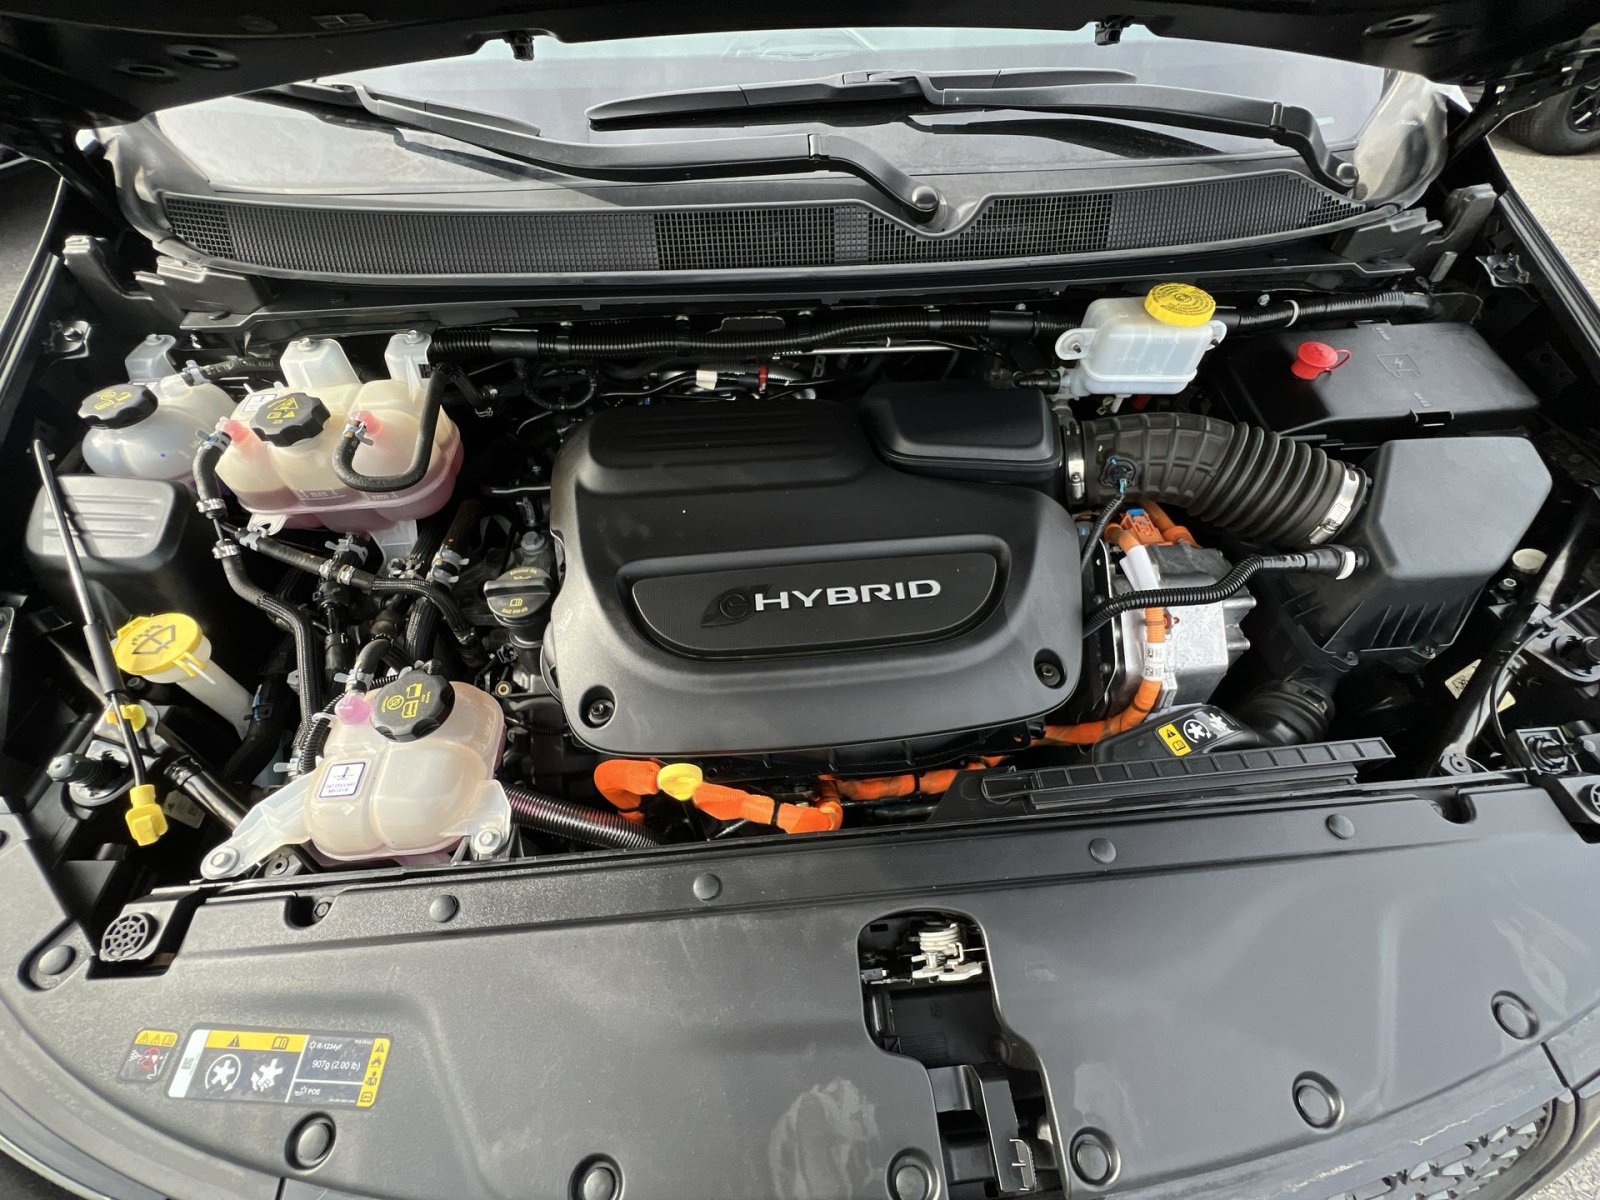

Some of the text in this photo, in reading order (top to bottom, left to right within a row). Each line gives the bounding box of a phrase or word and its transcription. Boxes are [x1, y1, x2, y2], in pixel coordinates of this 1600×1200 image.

[754, 579, 942, 612] HYBRID
[311, 1059, 331, 1071] 907g
[350, 1061, 361, 1072] lb)
